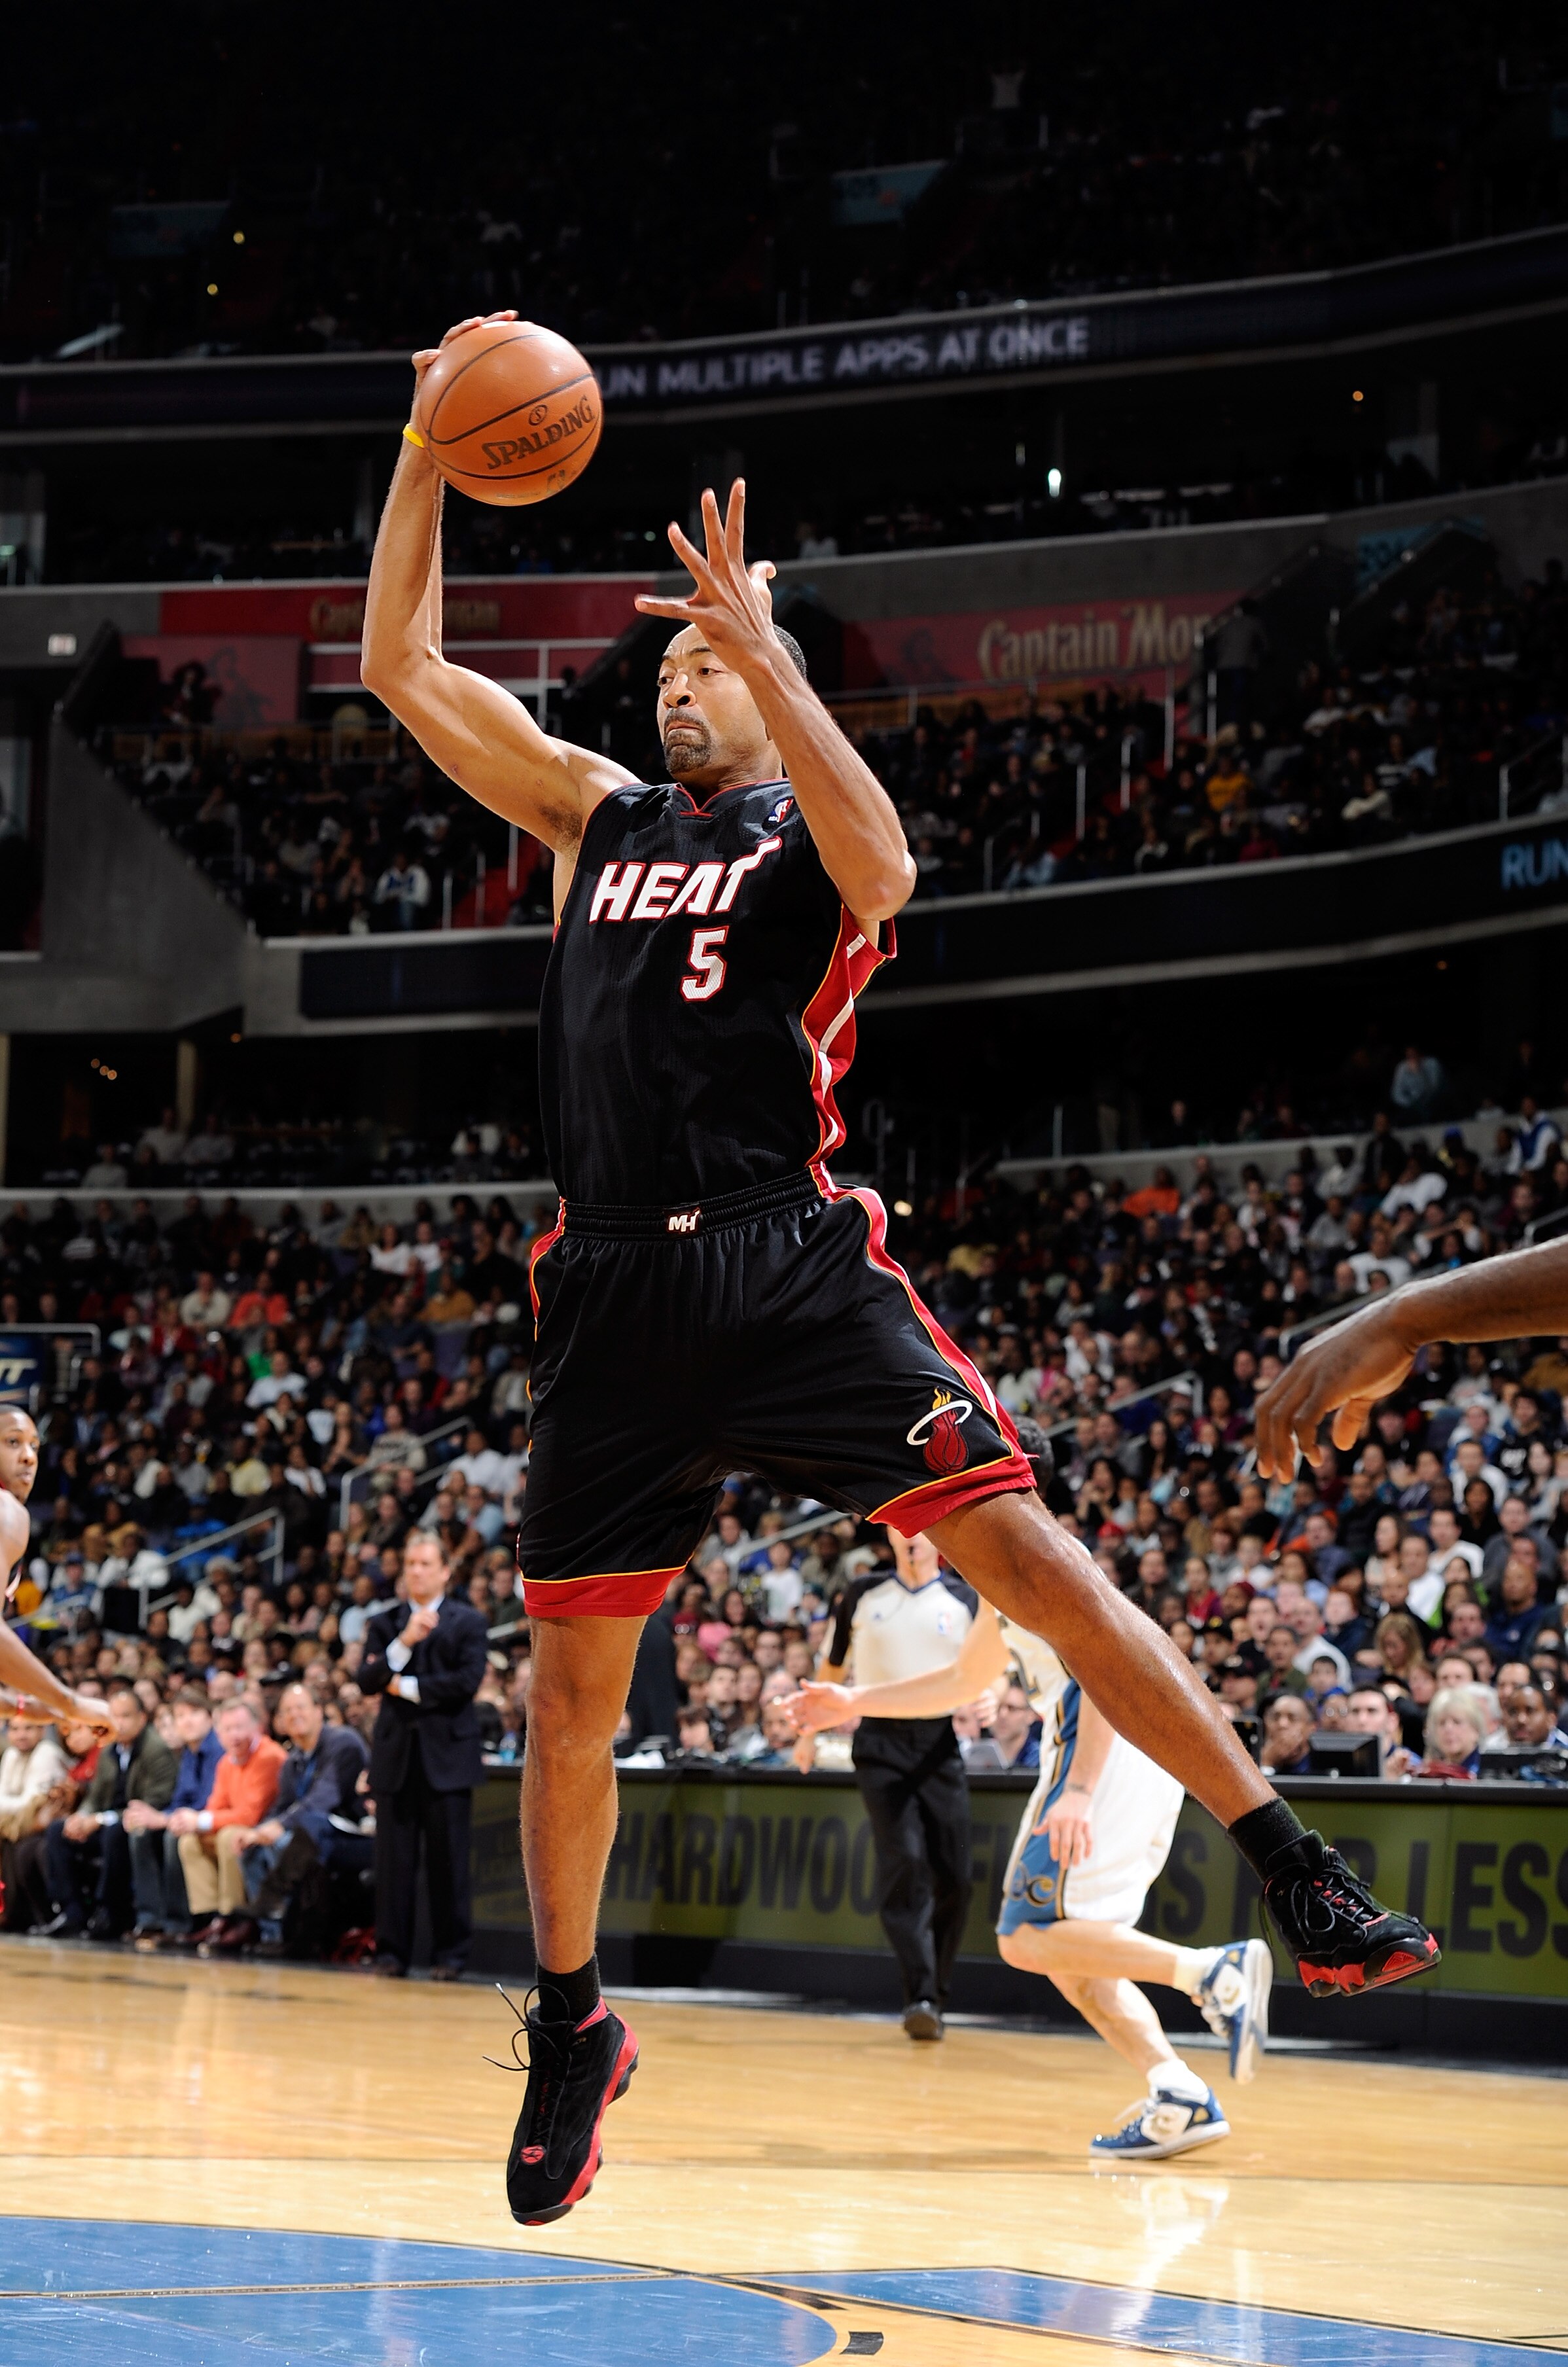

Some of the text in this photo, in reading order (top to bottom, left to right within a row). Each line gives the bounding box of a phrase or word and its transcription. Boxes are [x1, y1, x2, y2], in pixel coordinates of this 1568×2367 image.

[594, 315, 1089, 400] UN MULTIPLE APPS AT ONCE
[481, 395, 596, 470] SPALDING
[978, 602, 1212, 684] Captain Mor
[589, 836, 782, 925] HEAT
[1500, 838, 1568, 891] RUN
[679, 925, 729, 1001] 5
[606, 1810, 882, 1916] HARDWOO
